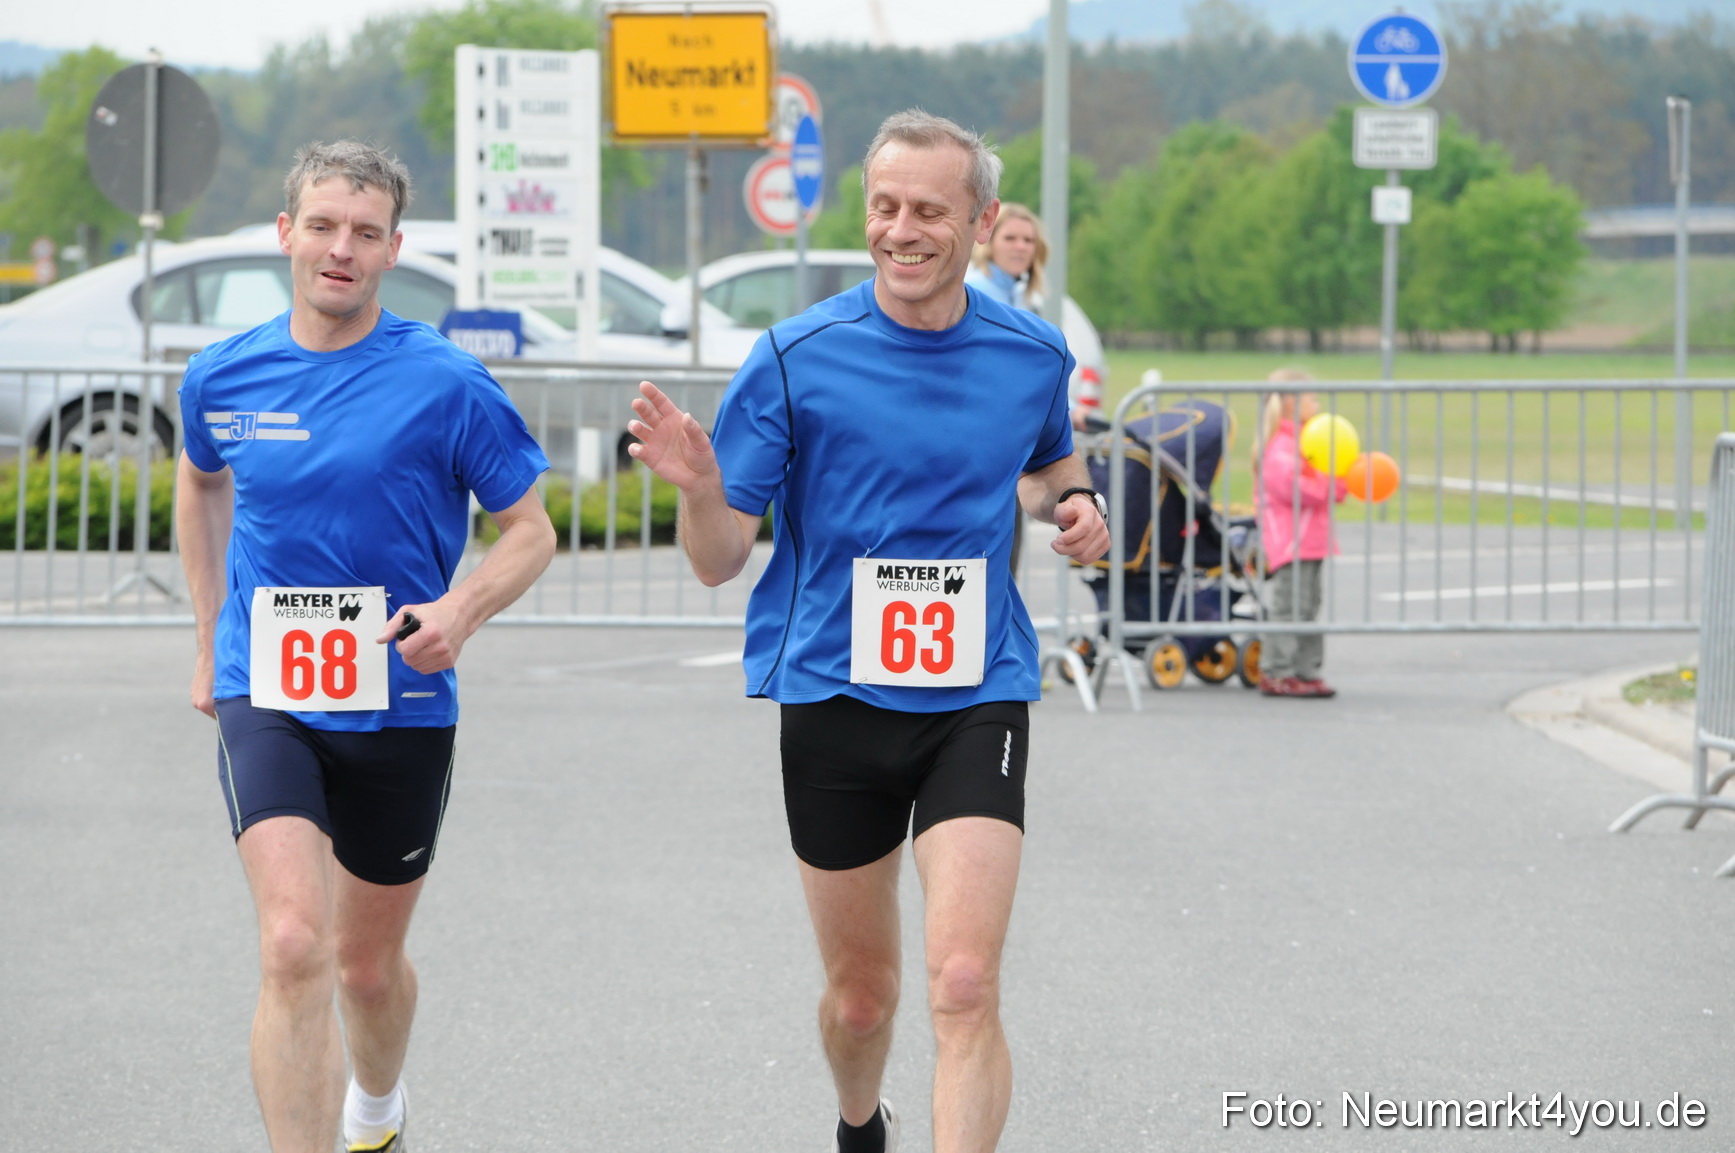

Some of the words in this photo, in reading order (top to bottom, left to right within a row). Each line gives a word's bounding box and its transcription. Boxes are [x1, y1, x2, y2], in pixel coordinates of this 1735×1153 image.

[626, 59, 756, 88] Neumarkt
[876, 564, 940, 580] MEYER
[876, 580, 940, 593] WERBUNG
[273, 593, 334, 608] MEYER
[273, 608, 335, 620] WERBUNG
[880, 600, 955, 675] 63
[281, 628, 357, 701] 68
